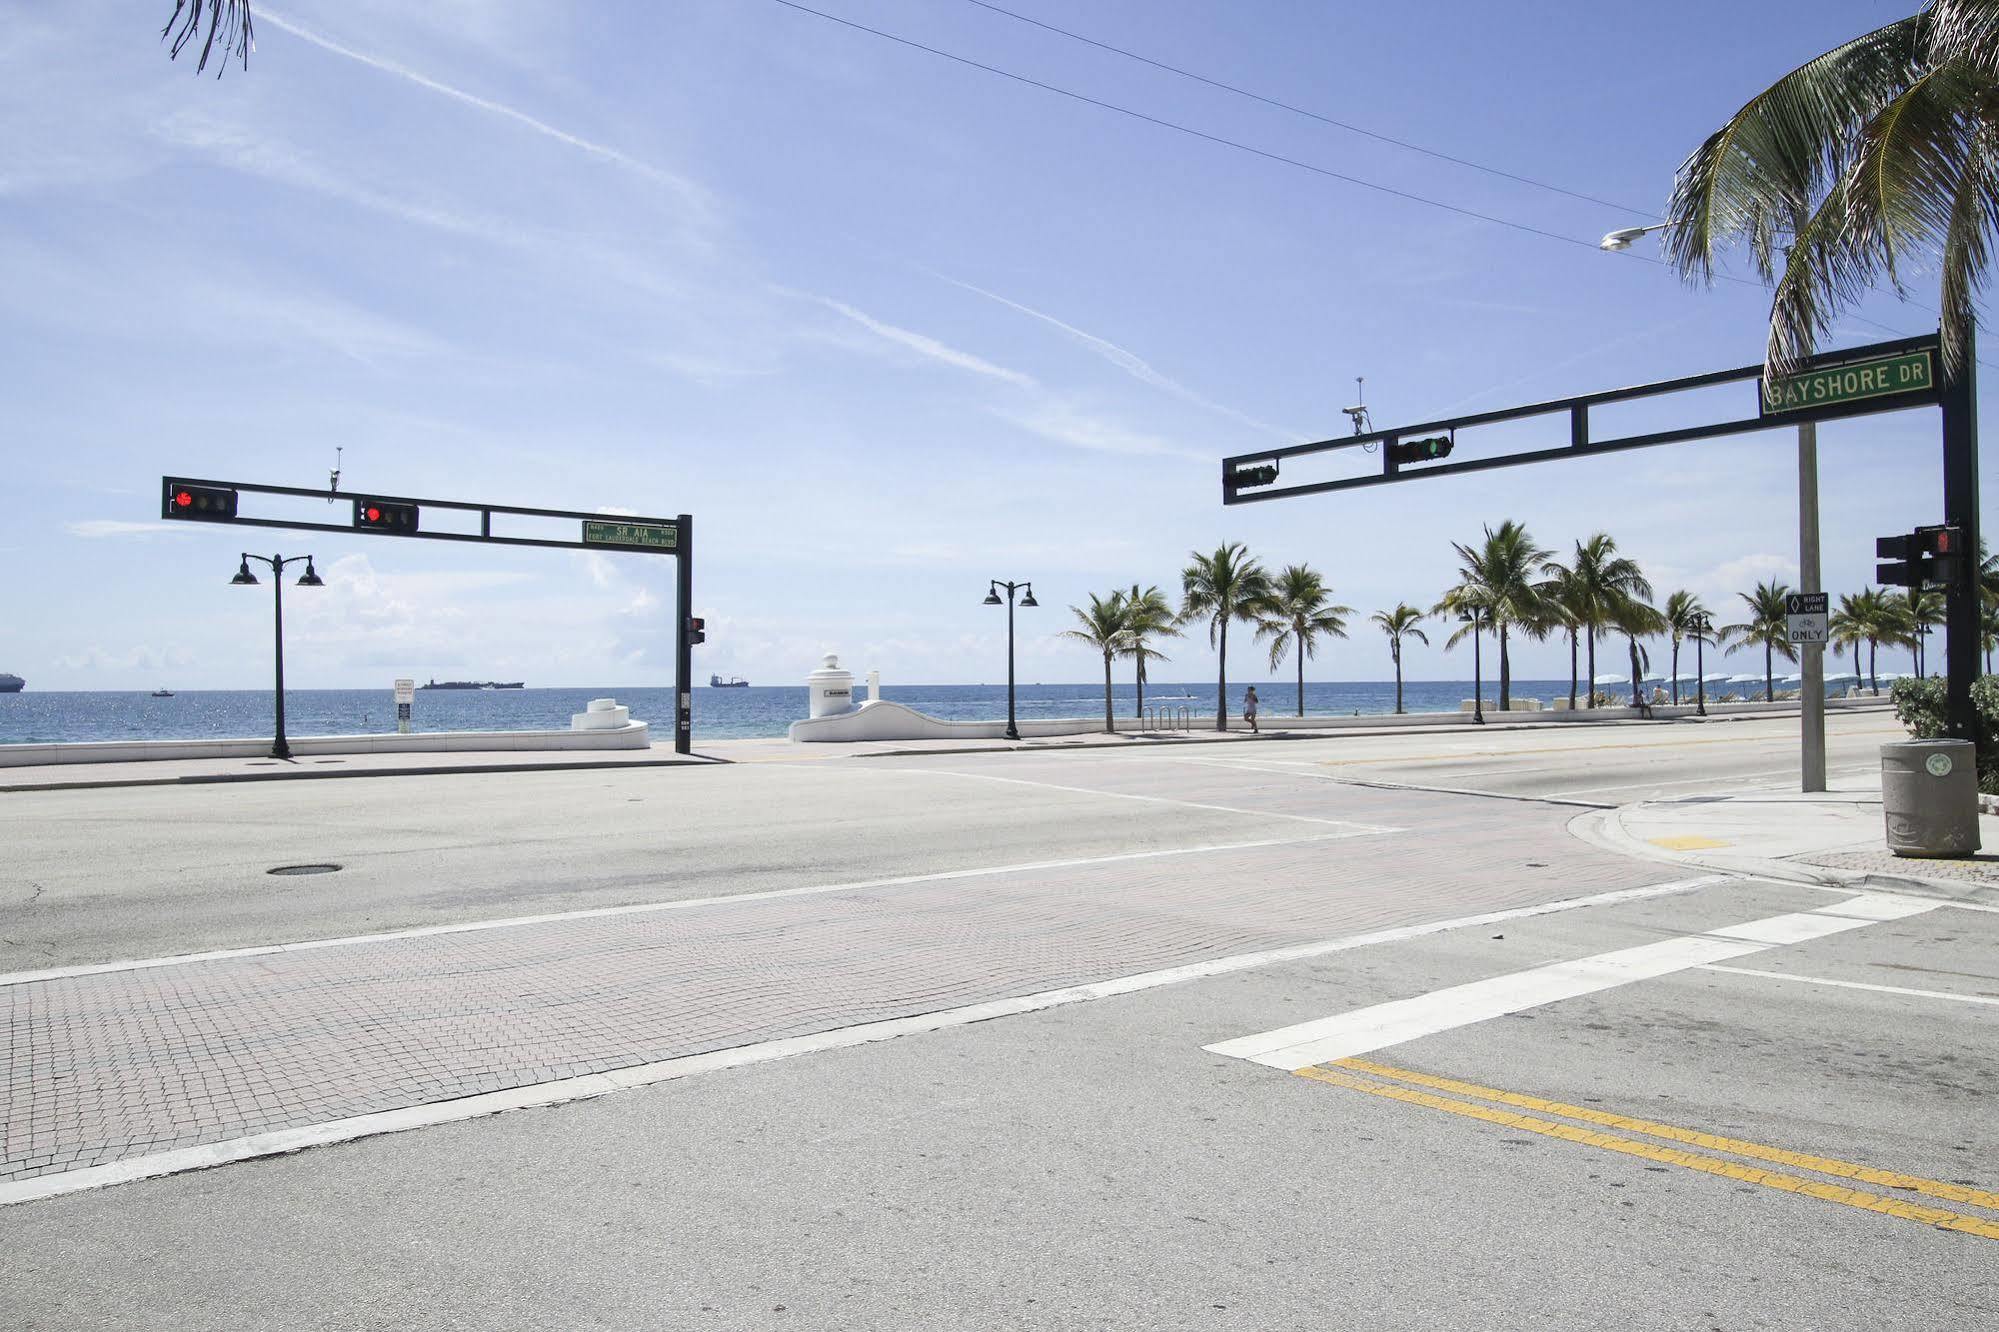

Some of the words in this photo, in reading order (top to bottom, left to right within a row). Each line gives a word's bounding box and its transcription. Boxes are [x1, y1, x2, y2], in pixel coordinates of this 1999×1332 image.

[1772, 367, 1890, 406] BAYSHORE
[1899, 362, 1924, 383] DR
[616, 526, 628, 537] SR
[661, 538, 675, 546] BLVD
[1805, 604, 1824, 612] LANE
[1792, 630, 1822, 640] ONLY
